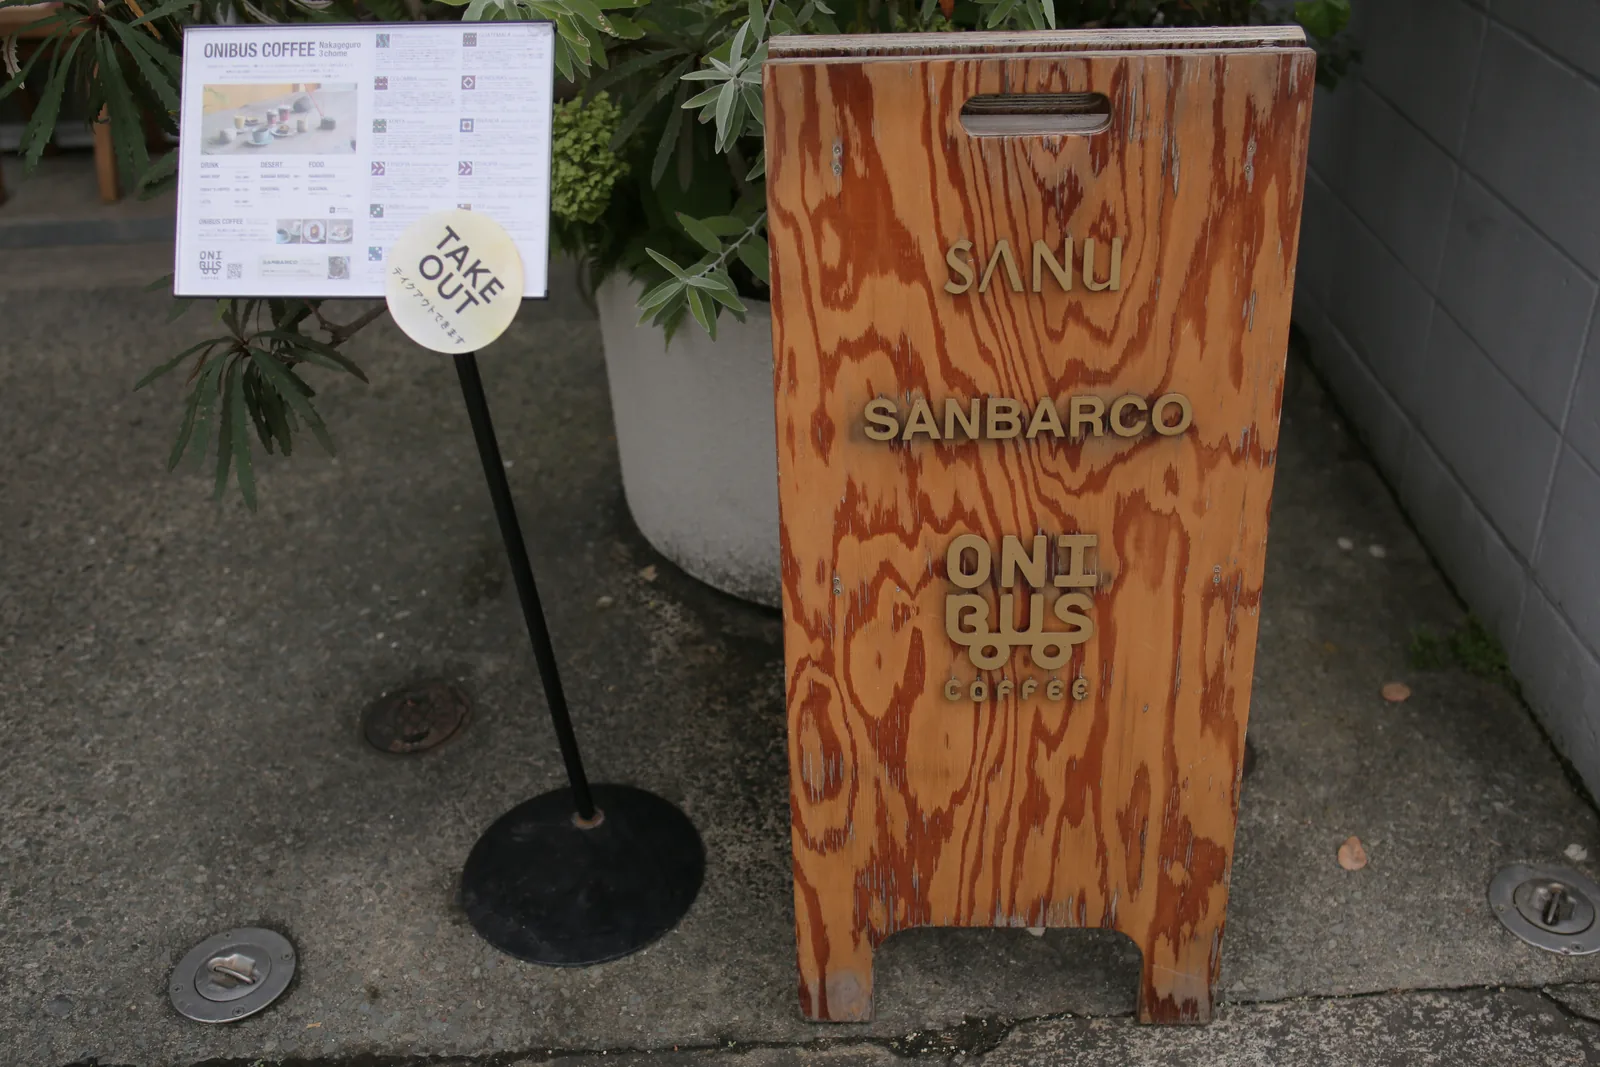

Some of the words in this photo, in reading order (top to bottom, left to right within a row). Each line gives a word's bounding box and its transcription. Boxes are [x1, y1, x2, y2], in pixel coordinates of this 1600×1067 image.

[204, 42, 257, 58] ONIBUS
[262, 41, 316, 57] COFFEE
[199, 261, 222, 274] BUS
[200, 251, 222, 260] ONI
[437, 225, 505, 304] TAKE
[944, 237, 1122, 294] SANU
[392, 267, 466, 344] テイクアウトできます
[418, 254, 480, 314] OUT
[864, 392, 1193, 441] SANBARCO
[947, 534, 1098, 589] ONI
[945, 592, 1095, 670] BUS
